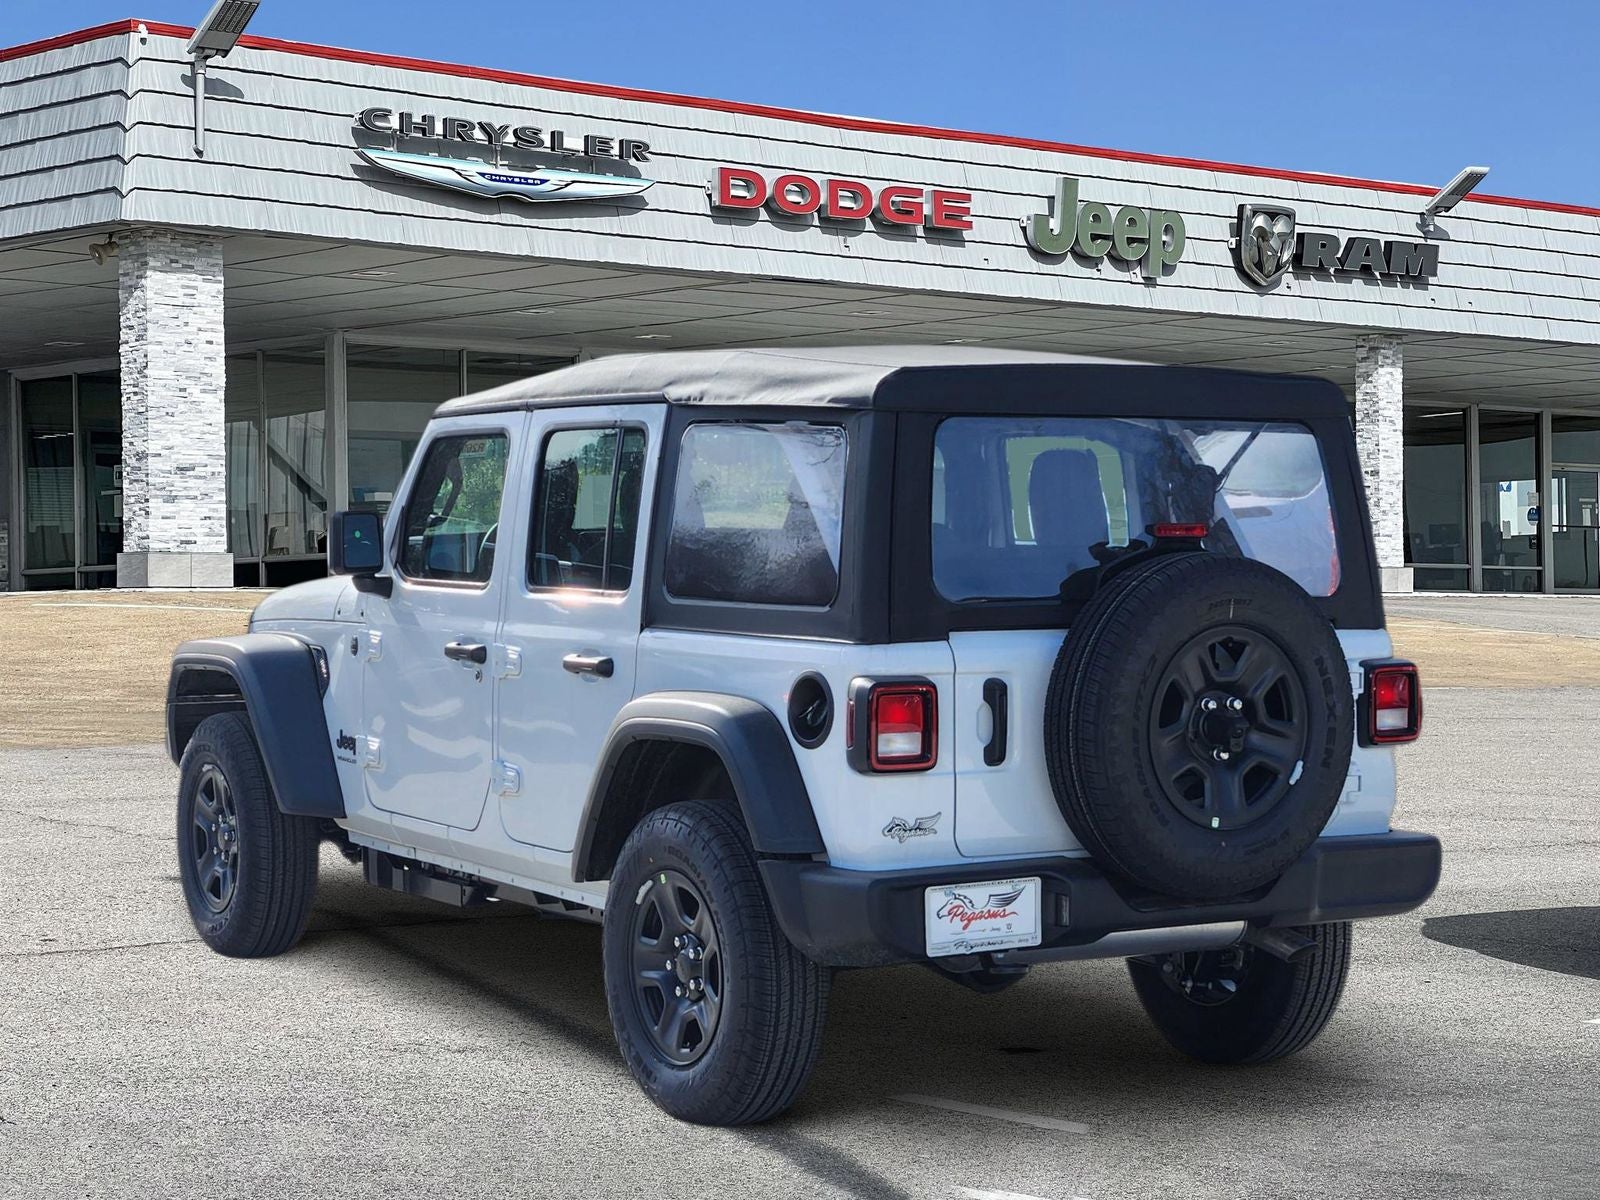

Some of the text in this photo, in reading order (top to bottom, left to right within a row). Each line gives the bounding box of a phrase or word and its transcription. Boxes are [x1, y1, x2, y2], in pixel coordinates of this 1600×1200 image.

[359, 107, 651, 162] CHRYSLER
[484, 174, 541, 185] CHRYSLER
[711, 167, 973, 230] DODGE
[1026, 177, 1186, 278] Jeep
[1296, 231, 1440, 277] RAM
[1314, 655, 1337, 769] NEXEN
[336, 729, 356, 755] Jeep
[947, 904, 1018, 930] Pegasus
